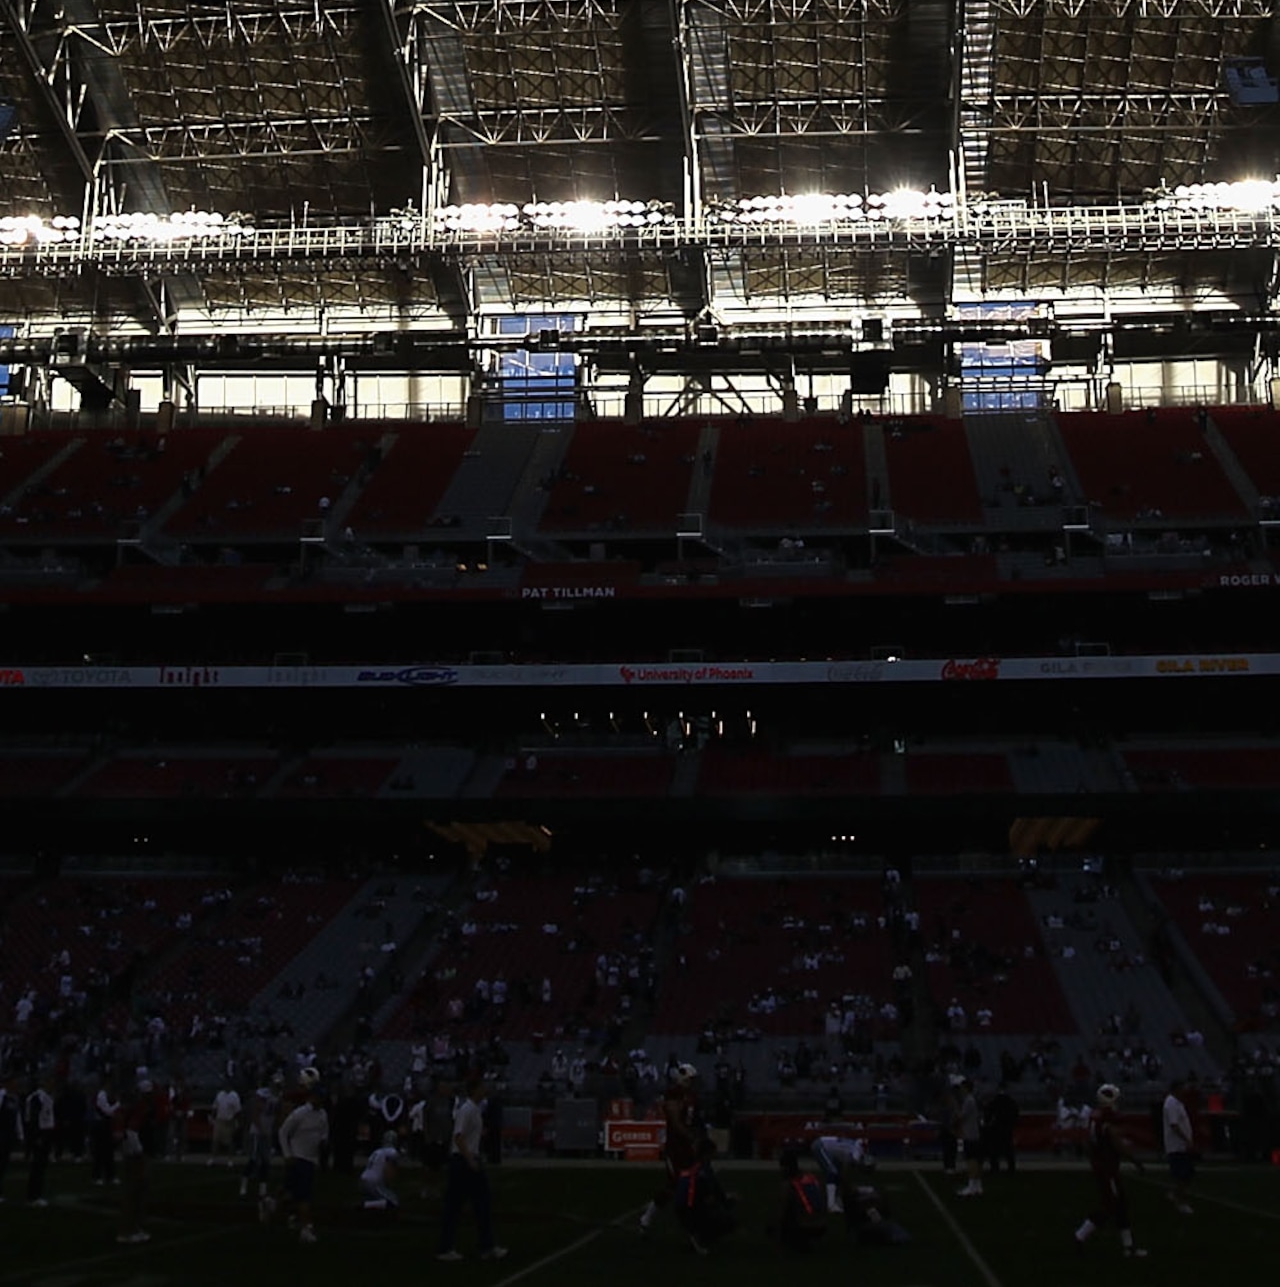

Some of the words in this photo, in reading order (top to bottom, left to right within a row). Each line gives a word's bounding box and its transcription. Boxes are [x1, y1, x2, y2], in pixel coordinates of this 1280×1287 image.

[1219, 574, 1271, 586] ROGER
[521, 587, 549, 599] PAT
[552, 586, 616, 598] TILLMAN
[1040, 661, 1077, 674] GILA
[1156, 660, 1194, 673] GILA
[1198, 658, 1249, 672] RIVER
[62, 669, 132, 684] TOYOTA
[637, 667, 693, 684] University
[694, 667, 707, 680] of
[708, 667, 754, 680] Phoenix
